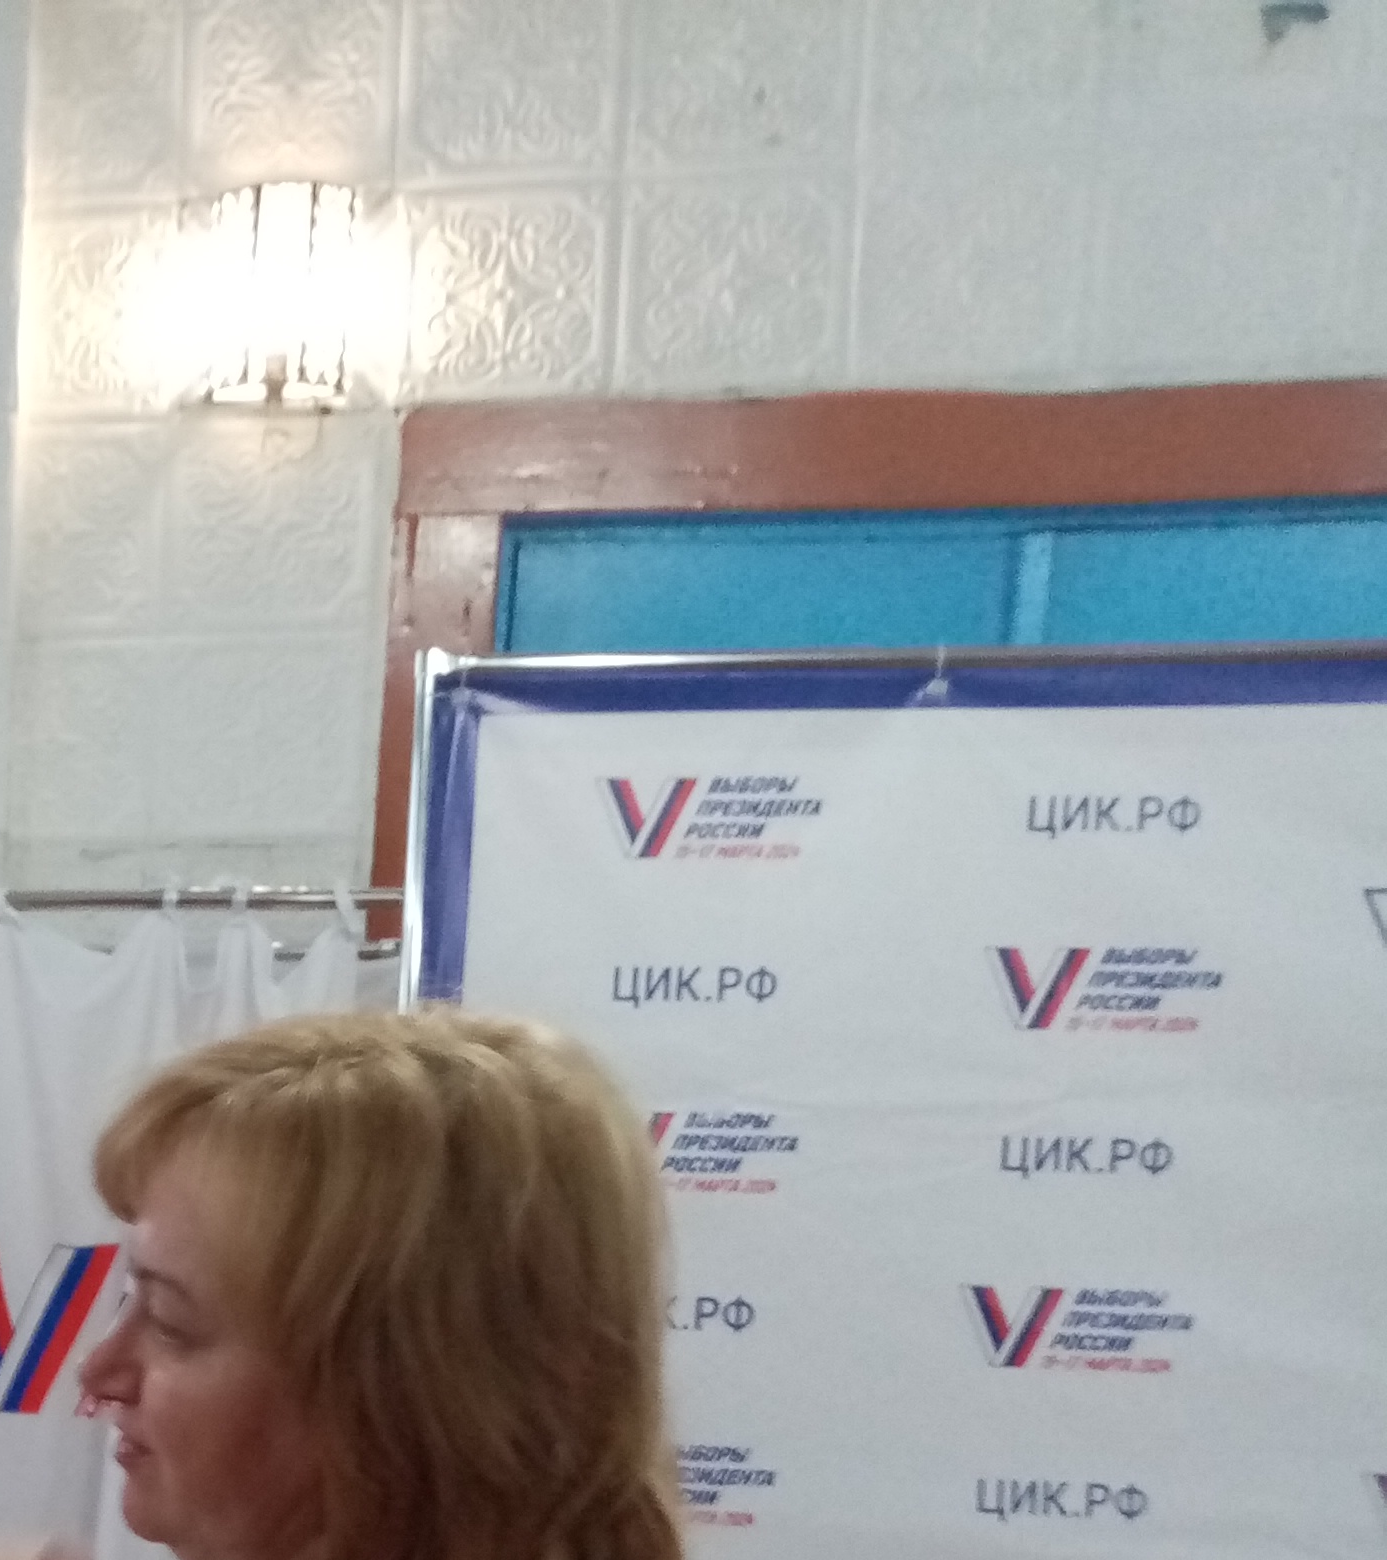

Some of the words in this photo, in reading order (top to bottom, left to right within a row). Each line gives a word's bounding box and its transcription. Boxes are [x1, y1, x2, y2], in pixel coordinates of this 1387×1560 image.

[1026, 795, 1202, 839] ЦИК.РФ
[612, 966, 778, 1009] ЦИК.РФ
[999, 1135, 1173, 1179] ЦИК.РФ
[975, 1478, 1149, 1522] ЦИК.РФ
